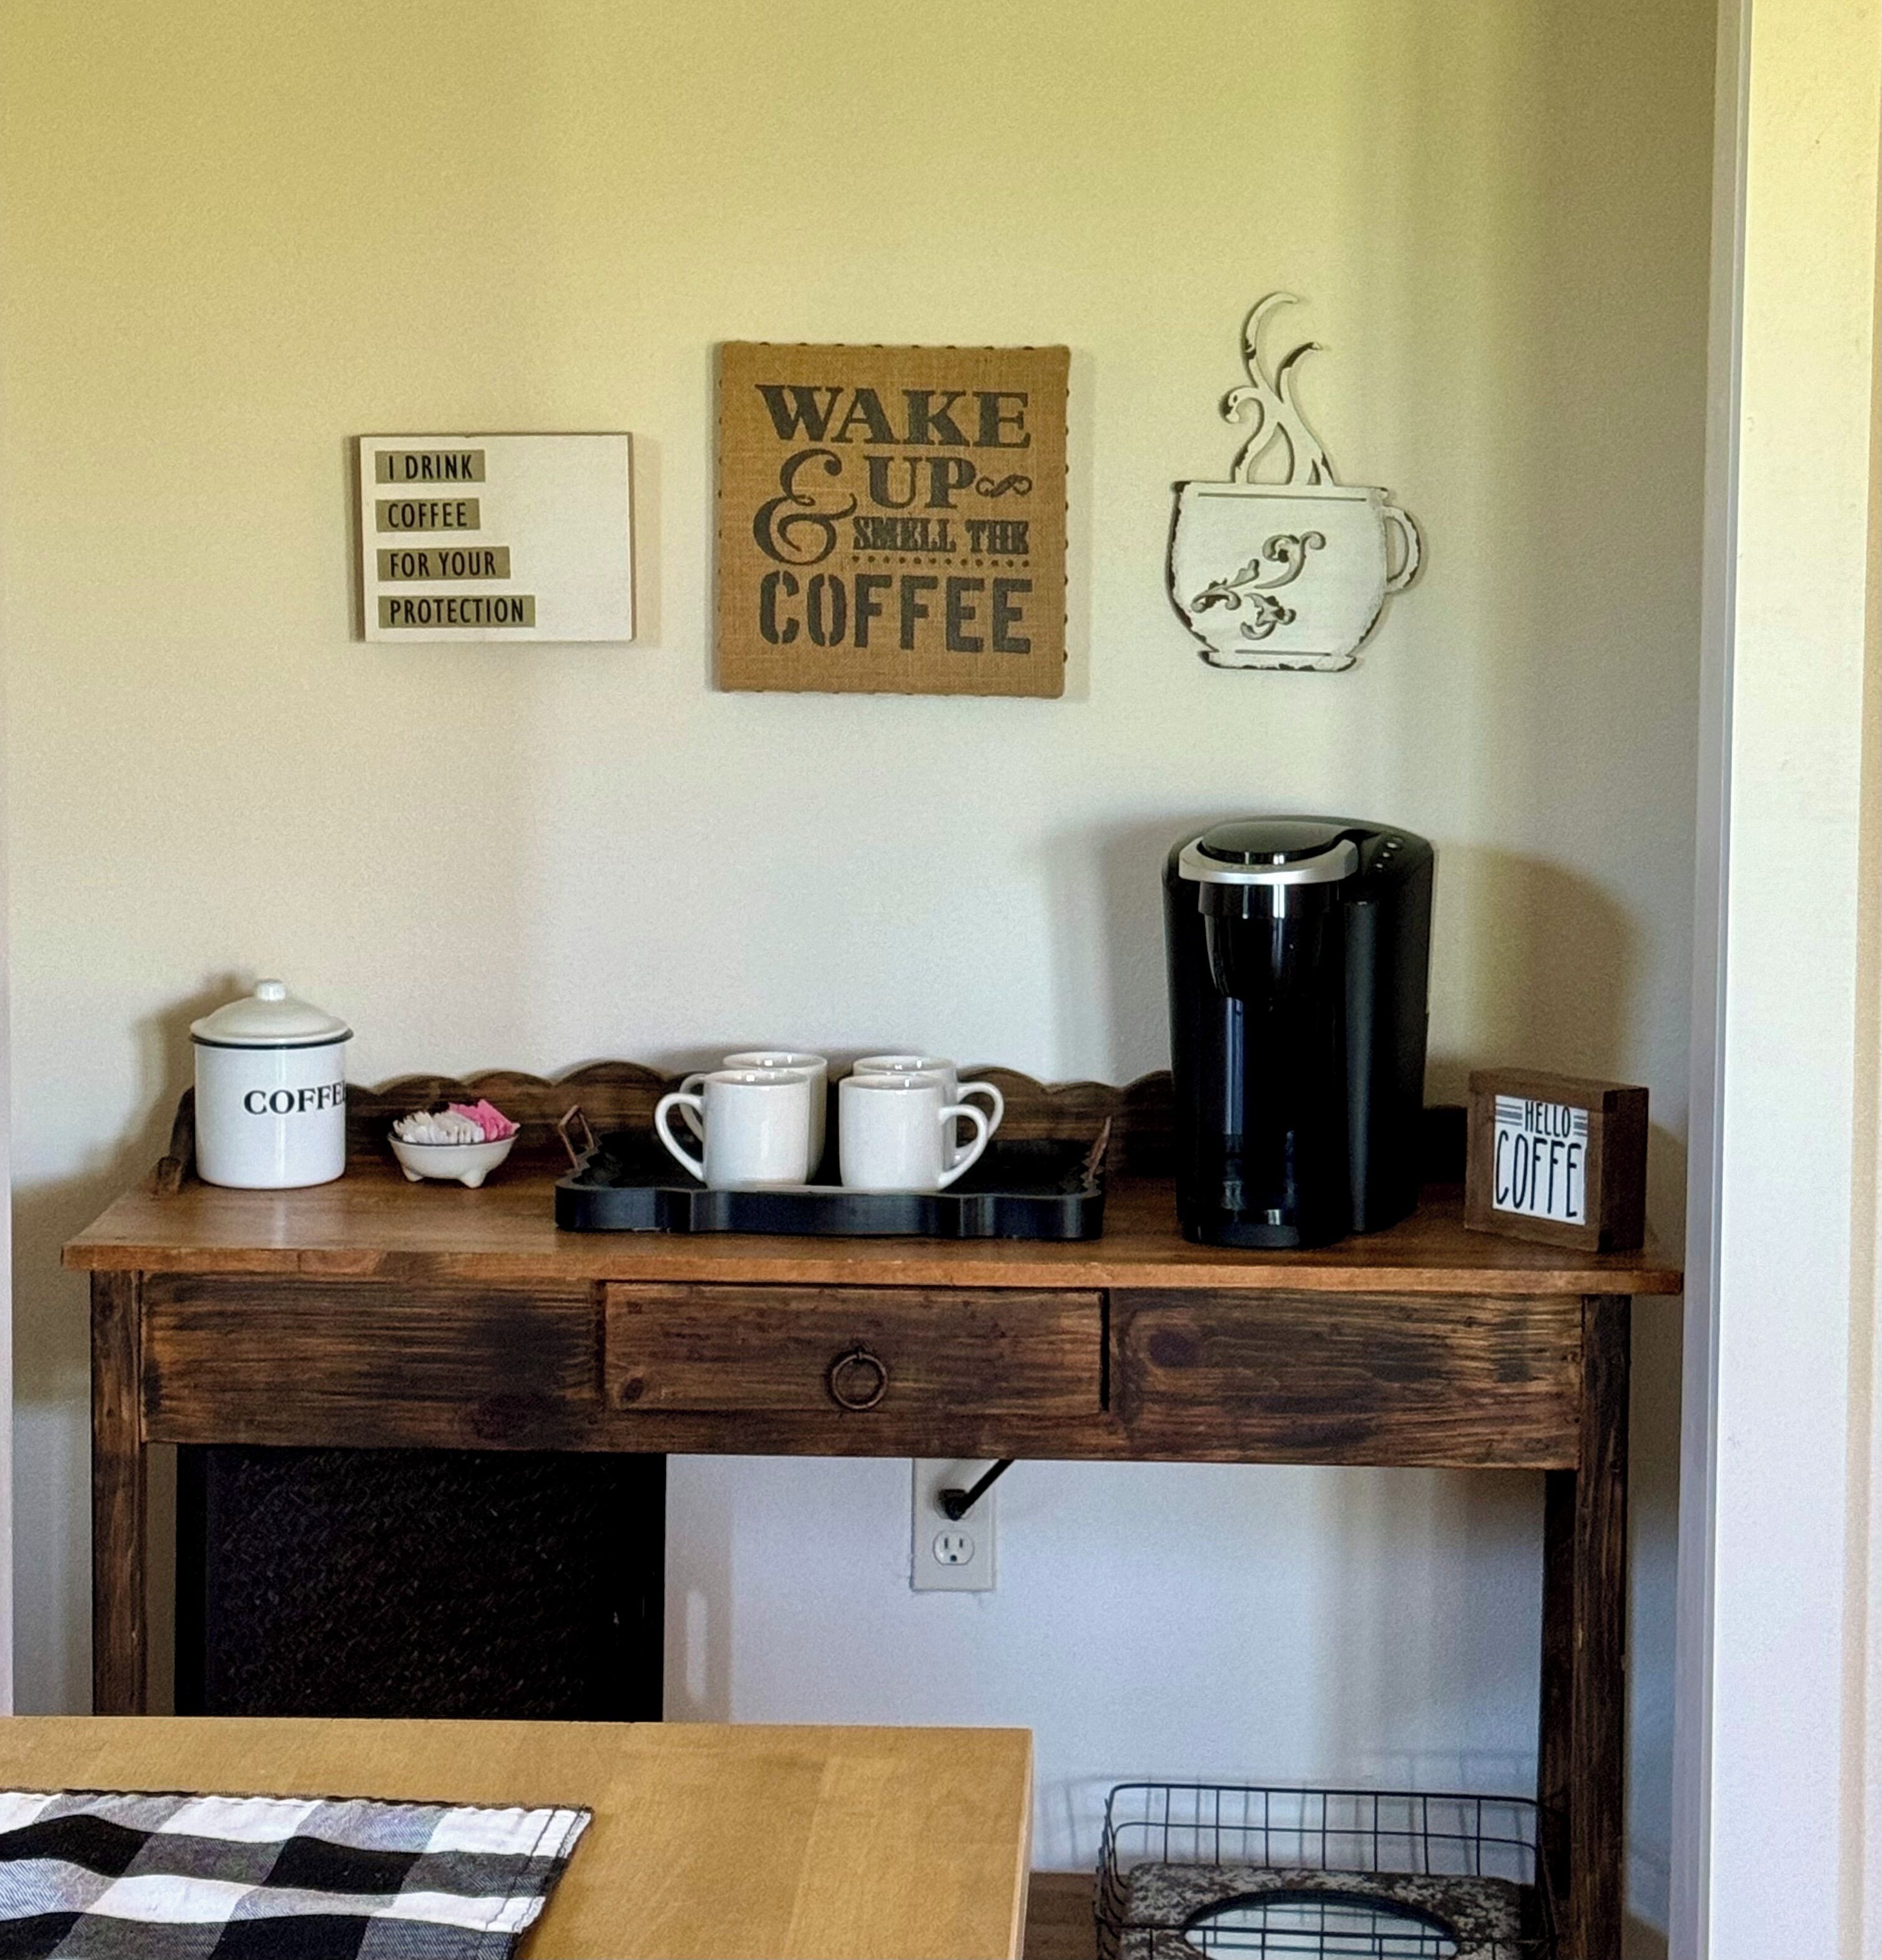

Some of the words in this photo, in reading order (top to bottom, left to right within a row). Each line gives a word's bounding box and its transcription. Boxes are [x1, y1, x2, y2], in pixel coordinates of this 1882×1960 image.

[754, 383, 1032, 449] WAKE
[388, 455, 394, 480] I
[405, 454, 473, 479] DRINK
[863, 454, 977, 509] UP
[387, 502, 468, 528] COFFEE
[852, 514, 957, 553] SMELL
[965, 519, 1030, 555] THE
[389, 552, 430, 578] FOR
[438, 551, 497, 577] YOUR
[389, 598, 524, 625] PROTECTION
[759, 569, 1033, 655] COFFEE
[1525, 1101, 1571, 1138] HELLO
